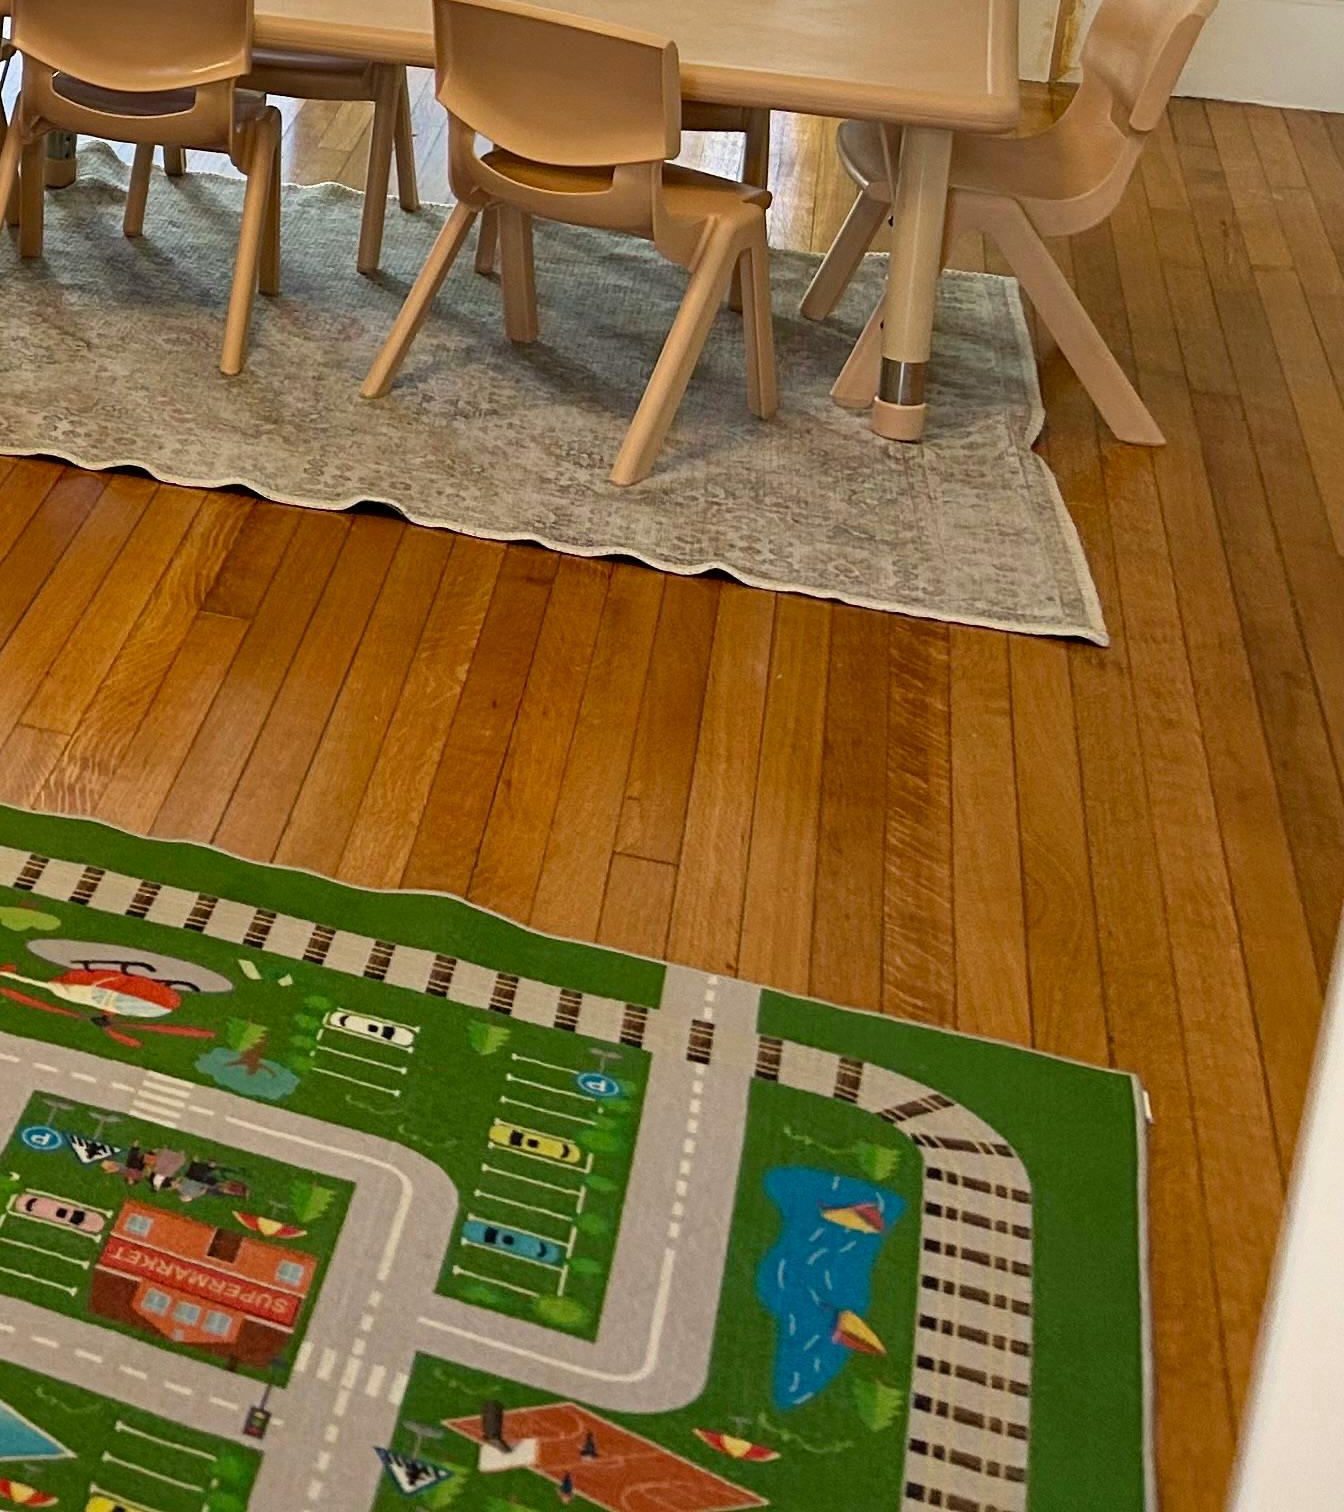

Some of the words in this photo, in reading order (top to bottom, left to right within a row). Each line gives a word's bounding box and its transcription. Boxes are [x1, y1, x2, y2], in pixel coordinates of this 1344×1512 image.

[587, 1080, 606, 1092] P
[31, 1132, 50, 1145] P
[108, 1246, 288, 1314] SUPERMARKET
